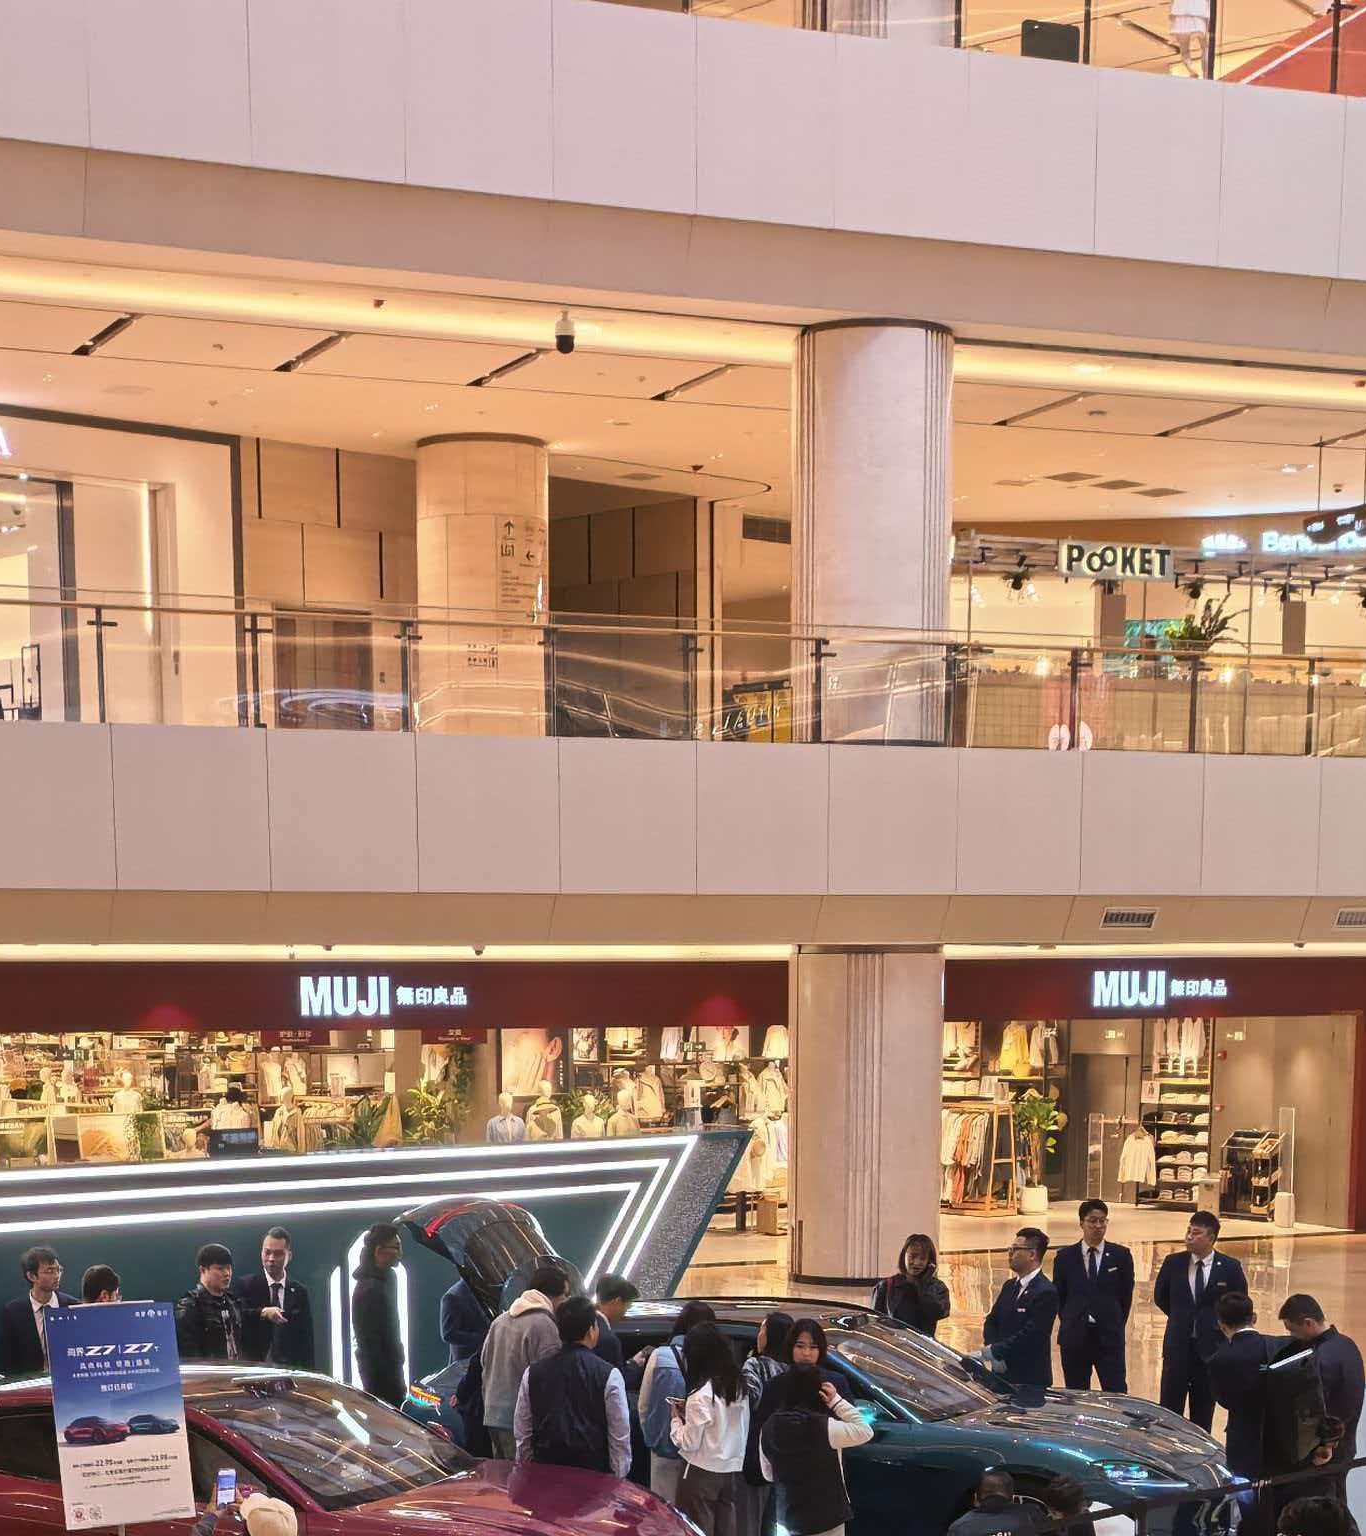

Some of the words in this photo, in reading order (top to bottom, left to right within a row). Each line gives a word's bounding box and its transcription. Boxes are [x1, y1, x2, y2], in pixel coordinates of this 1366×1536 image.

[299, 975, 391, 1017] MUJI
[396, 985, 468, 1006] 無印良品
[1093, 970, 1166, 1007] MUJI
[1170, 978, 1228, 997] 無印良品
